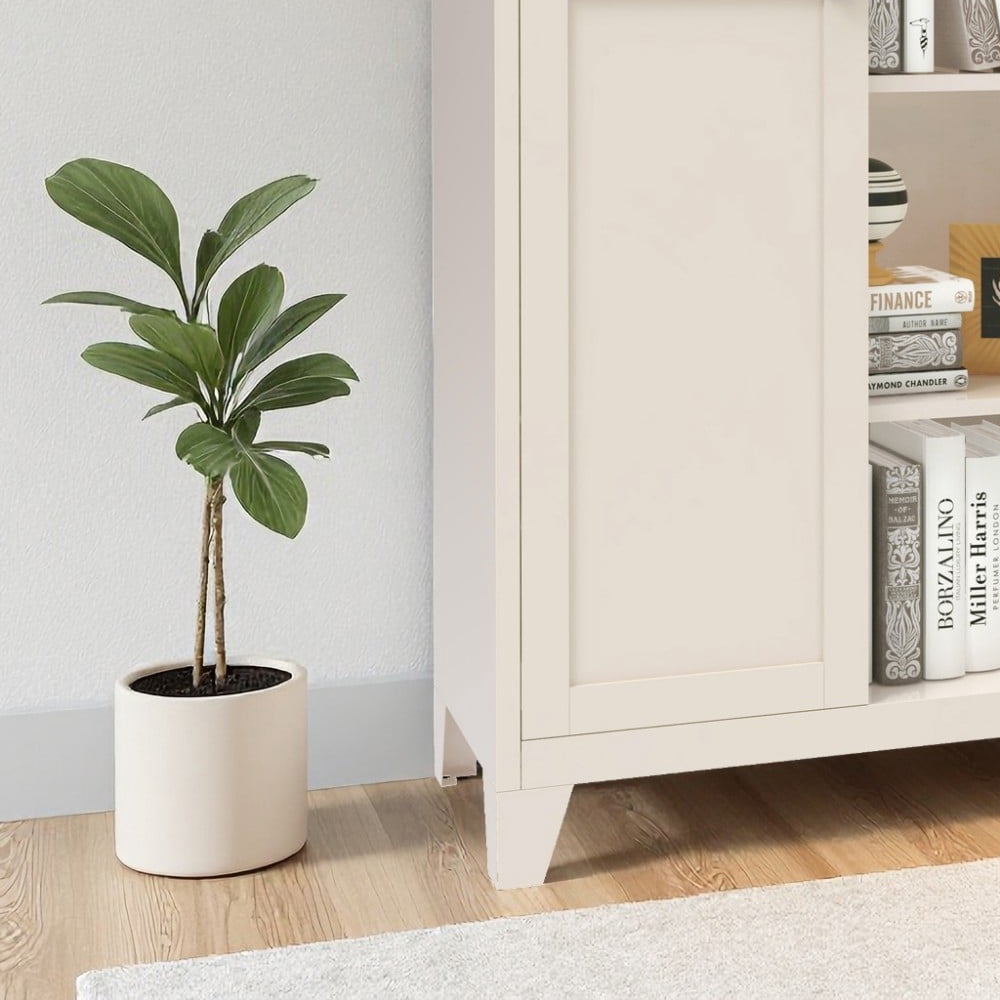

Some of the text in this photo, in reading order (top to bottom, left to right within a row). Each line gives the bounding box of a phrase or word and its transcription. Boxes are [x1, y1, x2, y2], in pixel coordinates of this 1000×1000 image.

[870, 290, 932, 311] FINANCE
[903, 318, 948, 329] AUTHOR NAME
[905, 378, 948, 388] CHANDLER
[888, 495, 918, 504] MEMOIR
[888, 514, 916, 523] BALZAC
[969, 491, 987, 626] Miller Harris
[937, 498, 954, 631] BORZALINO
